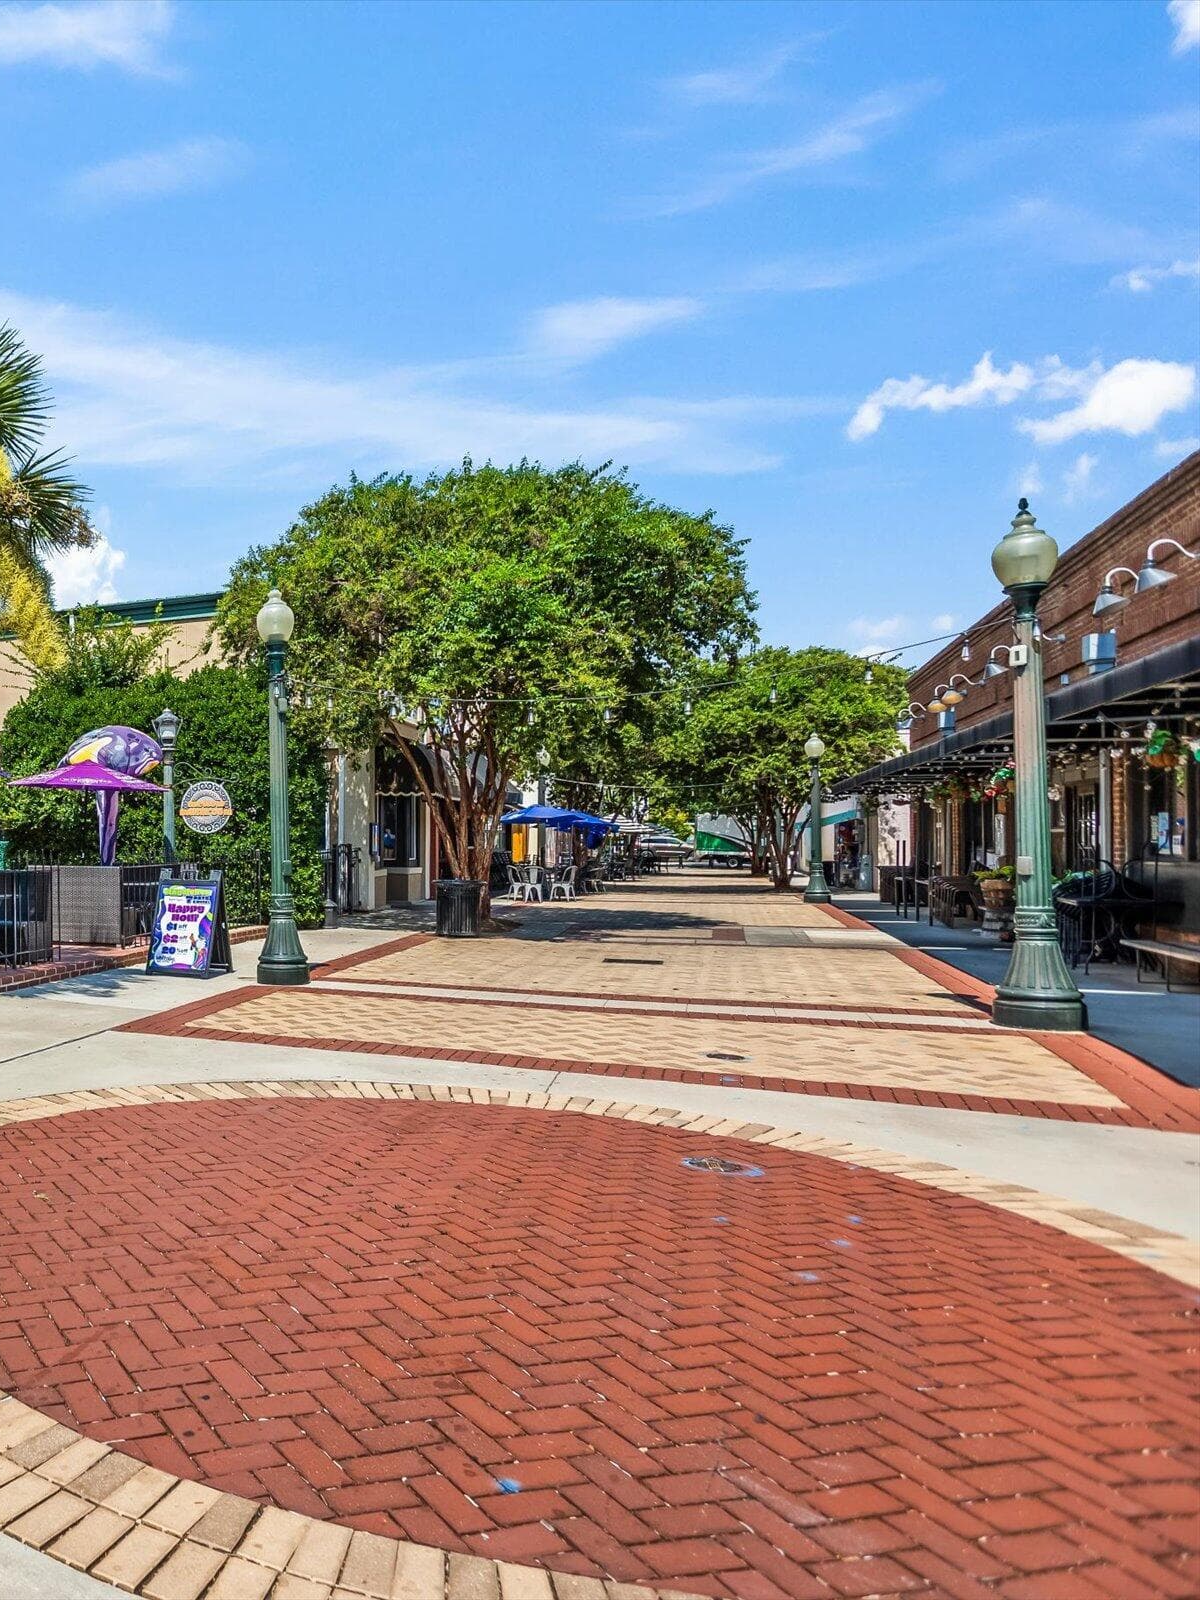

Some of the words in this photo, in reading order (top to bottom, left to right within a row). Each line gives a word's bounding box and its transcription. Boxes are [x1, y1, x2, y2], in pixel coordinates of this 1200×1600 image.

[168, 903, 205, 914] Happy
[171, 914, 199, 922] Hour
[163, 933, 178, 943] $2
[161, 946, 176, 954] 20
